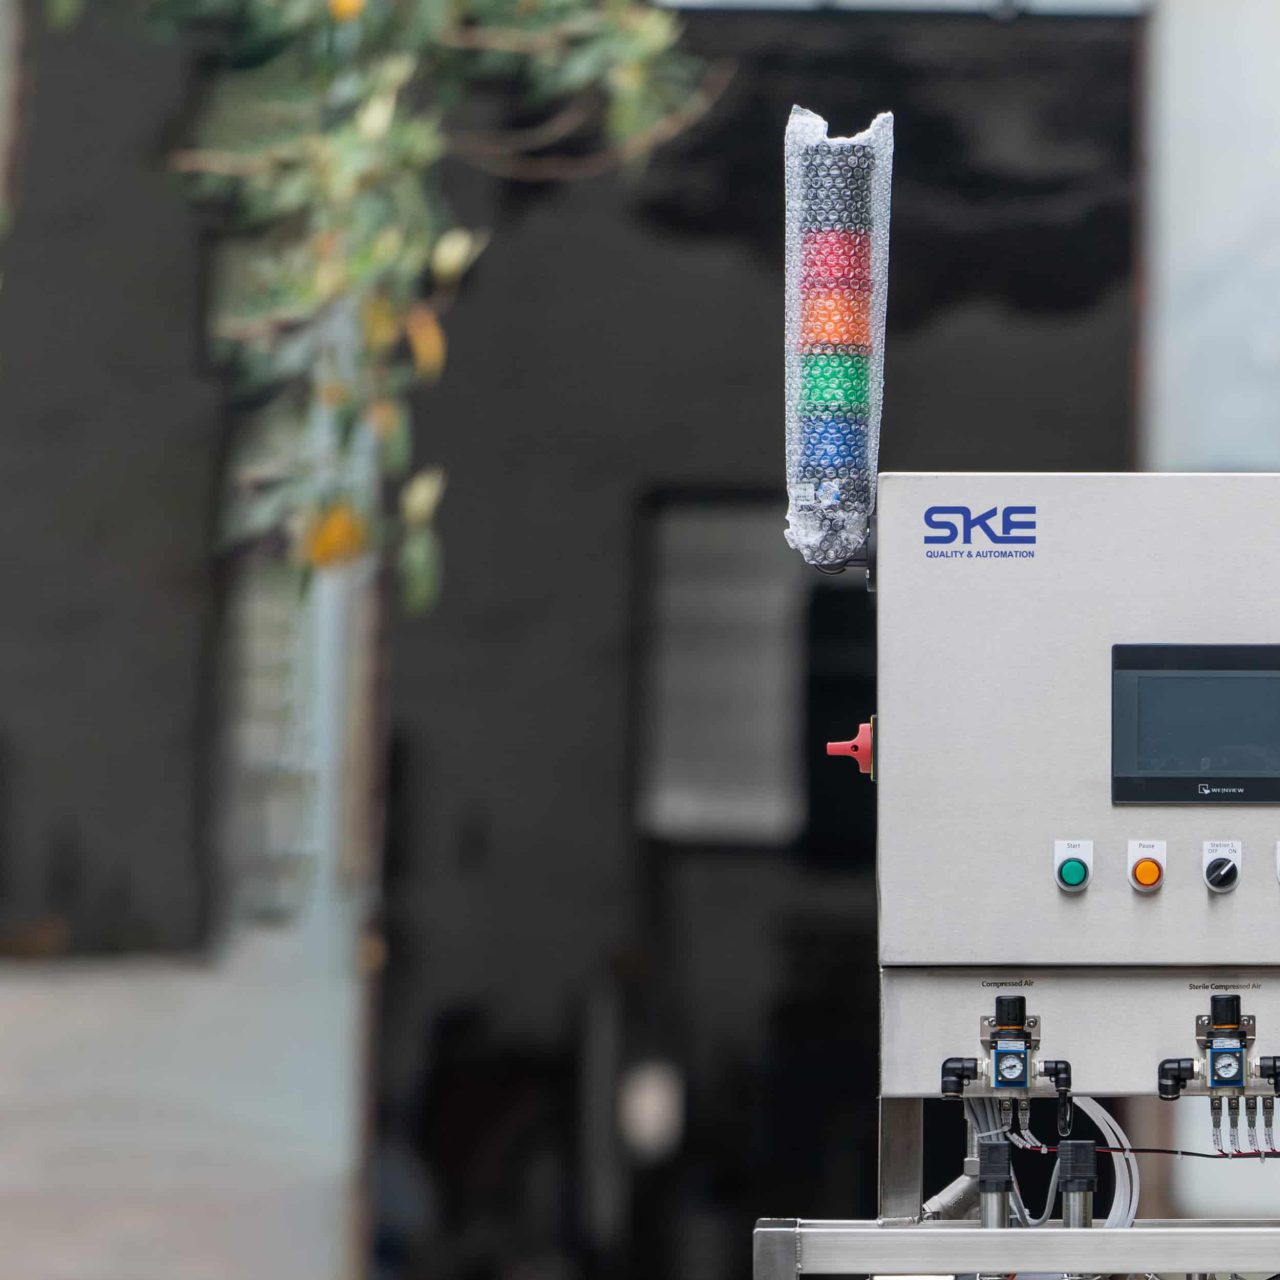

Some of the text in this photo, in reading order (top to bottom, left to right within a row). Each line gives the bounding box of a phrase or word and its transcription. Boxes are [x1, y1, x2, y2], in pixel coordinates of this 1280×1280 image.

[923, 505, 1037, 545] SKE
[925, 549, 1035, 559] QUALITY & AUTOMATION
[981, 979, 1023, 988] Compressed
[1210, 983, 1251, 991] Compressed
